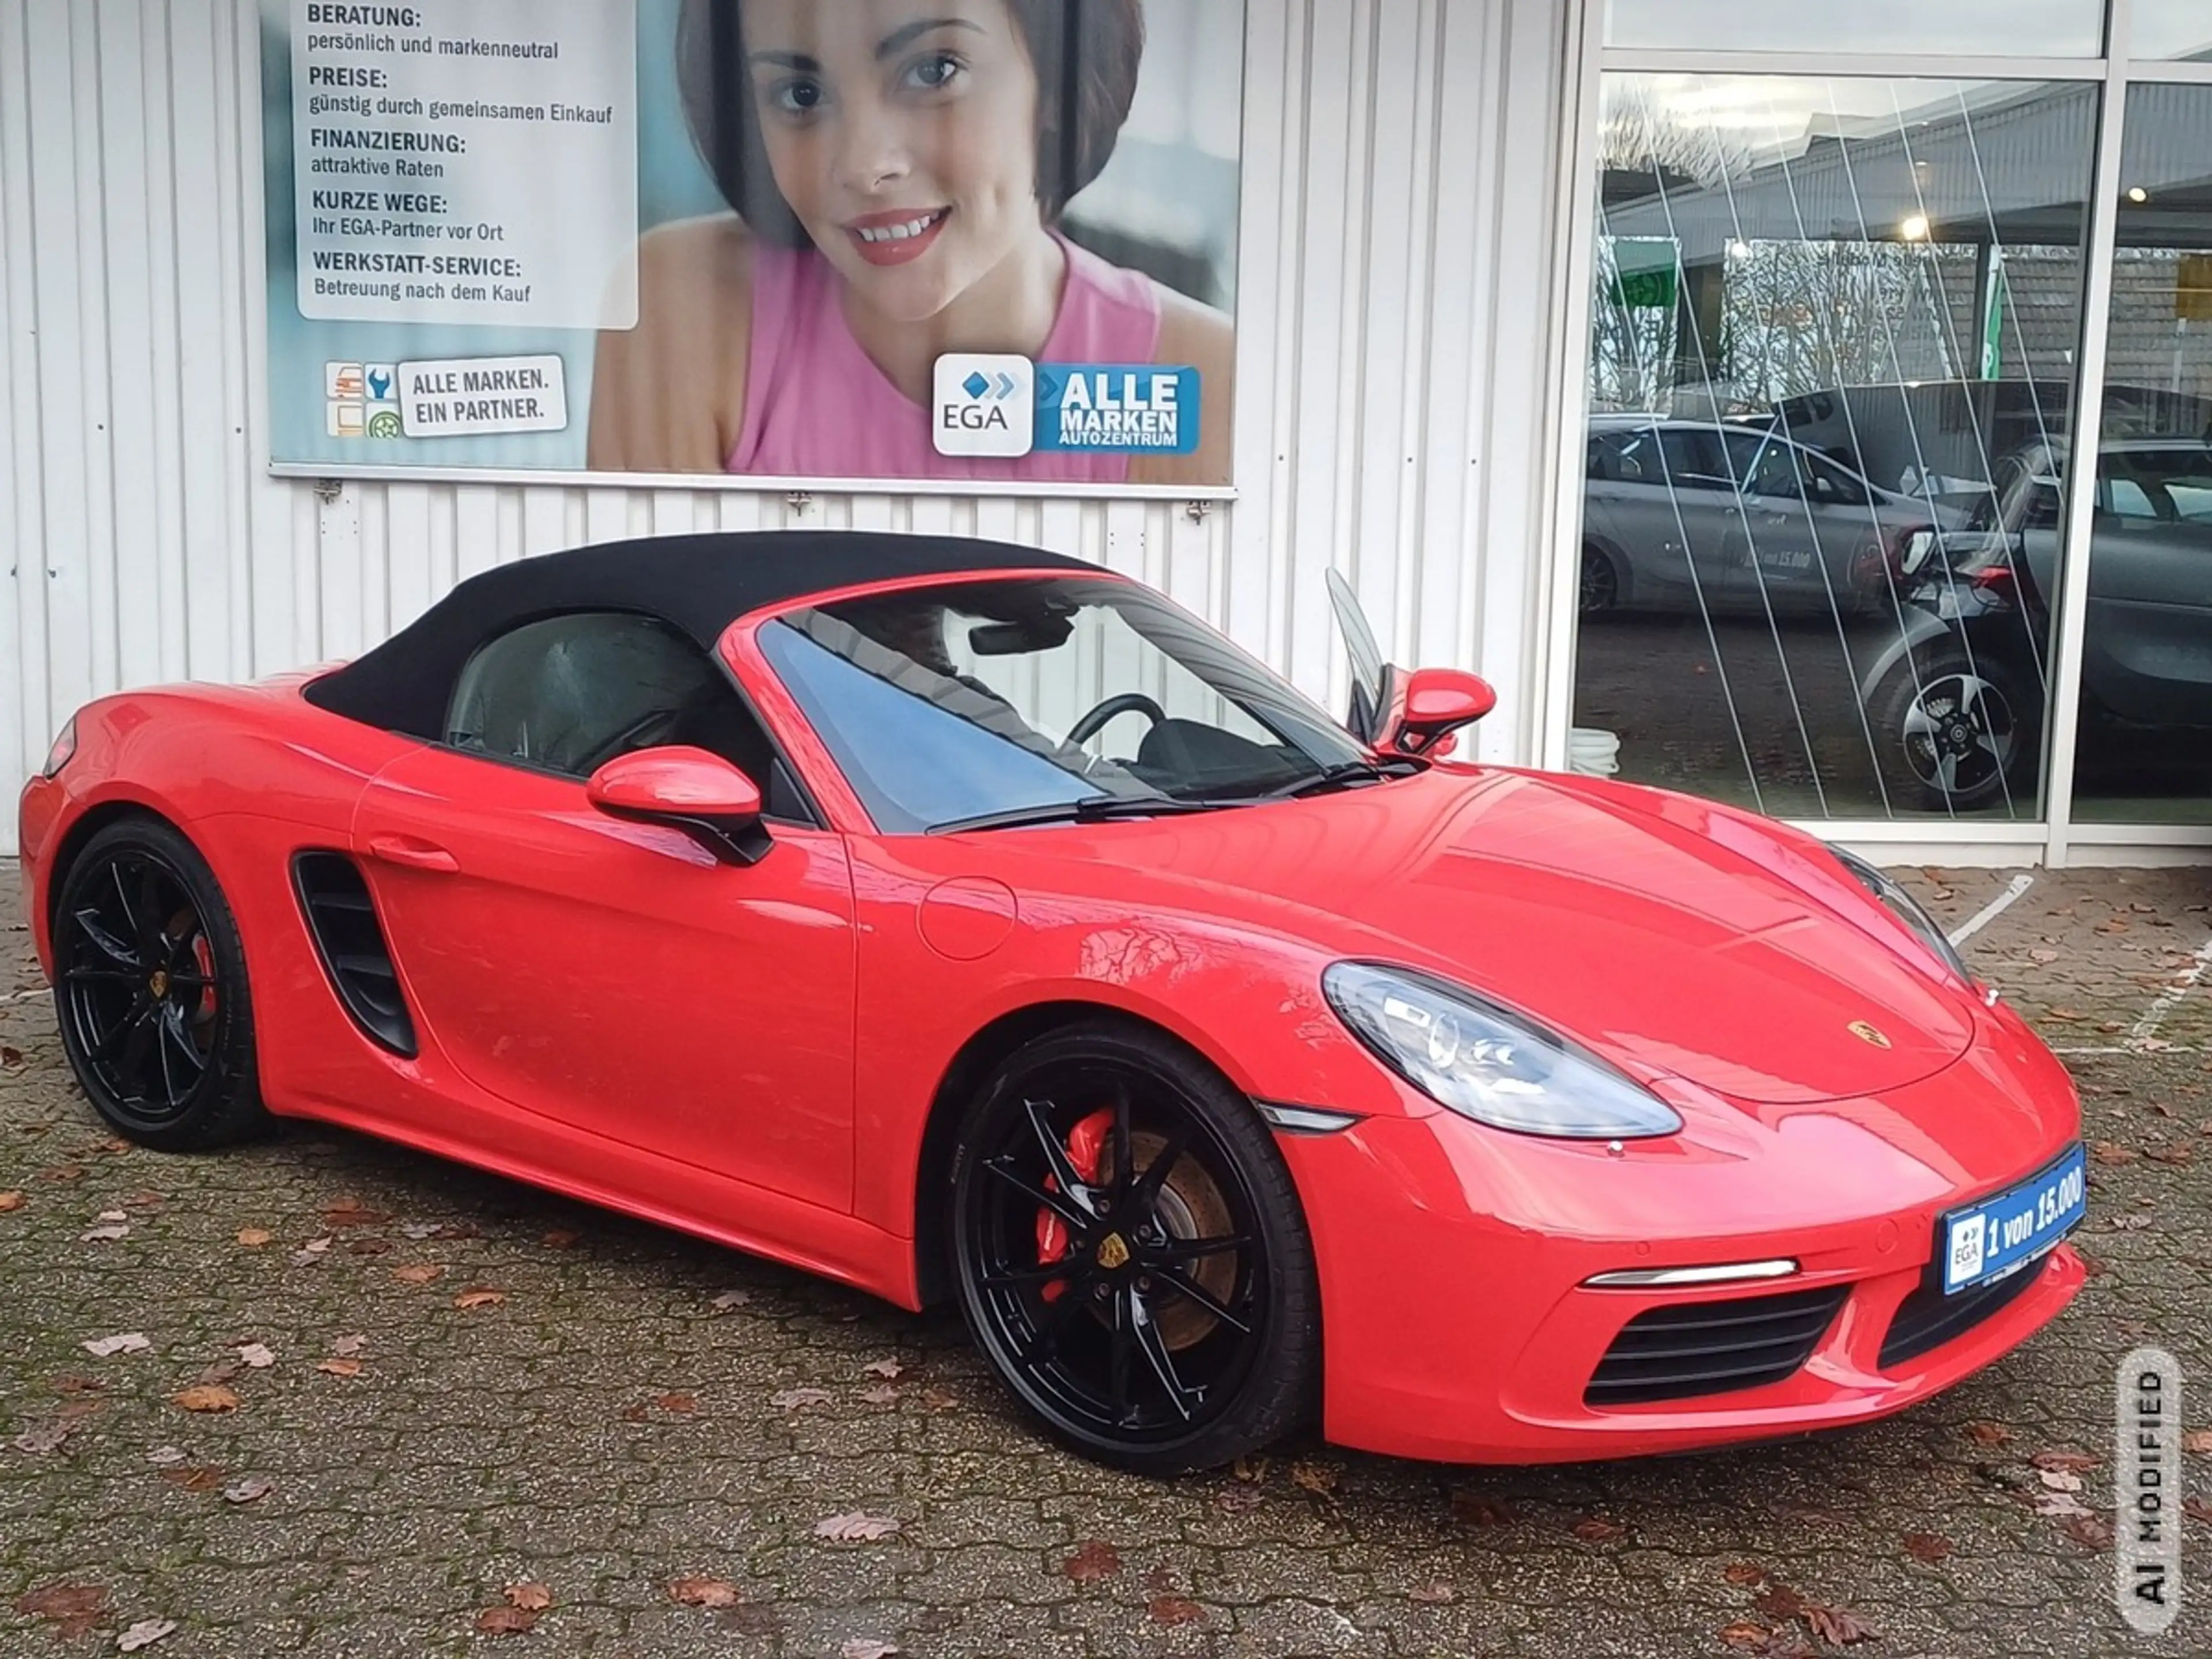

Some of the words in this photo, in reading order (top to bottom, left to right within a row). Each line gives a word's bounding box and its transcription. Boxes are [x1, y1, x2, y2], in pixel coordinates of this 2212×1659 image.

[308, 3, 421, 26] BERATUNG:
[308, 32, 395, 52] persönlich
[402, 36, 432, 53] und
[438, 38, 558, 59] markenneutral
[309, 66, 387, 88] PREISE:
[309, 94, 372, 116] günstig
[376, 97, 423, 115] durch
[429, 100, 544, 120] gemeinsamen
[550, 104, 612, 123] Einkauf
[310, 128, 465, 153] FINANZIERUNG:
[311, 157, 389, 175] attraktive
[396, 158, 444, 177] Raten
[312, 190, 378, 210] KURZE
[384, 193, 447, 213] WEGE:
[312, 217, 335, 233] Ihr
[341, 218, 442, 238] EGA-Partner
[447, 225, 472, 240] vor
[477, 223, 504, 241] Ort
[313, 251, 521, 277] WERKSTATT-SERVICE:
[315, 278, 400, 301] Betreuung
[406, 283, 445, 299] nach
[451, 283, 486, 301] dem
[493, 285, 531, 302] Kauf
[412, 372, 457, 395] ALLE
[463, 369, 549, 393] MARKEN.
[1060, 372, 1179, 411] ALLE
[416, 403, 447, 423] EIN
[454, 398, 544, 421] PARTNER.
[943, 404, 1007, 430] EGA
[1059, 410, 1177, 433] MARKEN
[1059, 431, 1177, 446] AUTOZENTRUM
[1987, 1218, 1999, 1258] 1
[2003, 1210, 2033, 1249] von
[2036, 1166, 2082, 1232] 15.000
[1955, 1243, 1979, 1265] EGA
